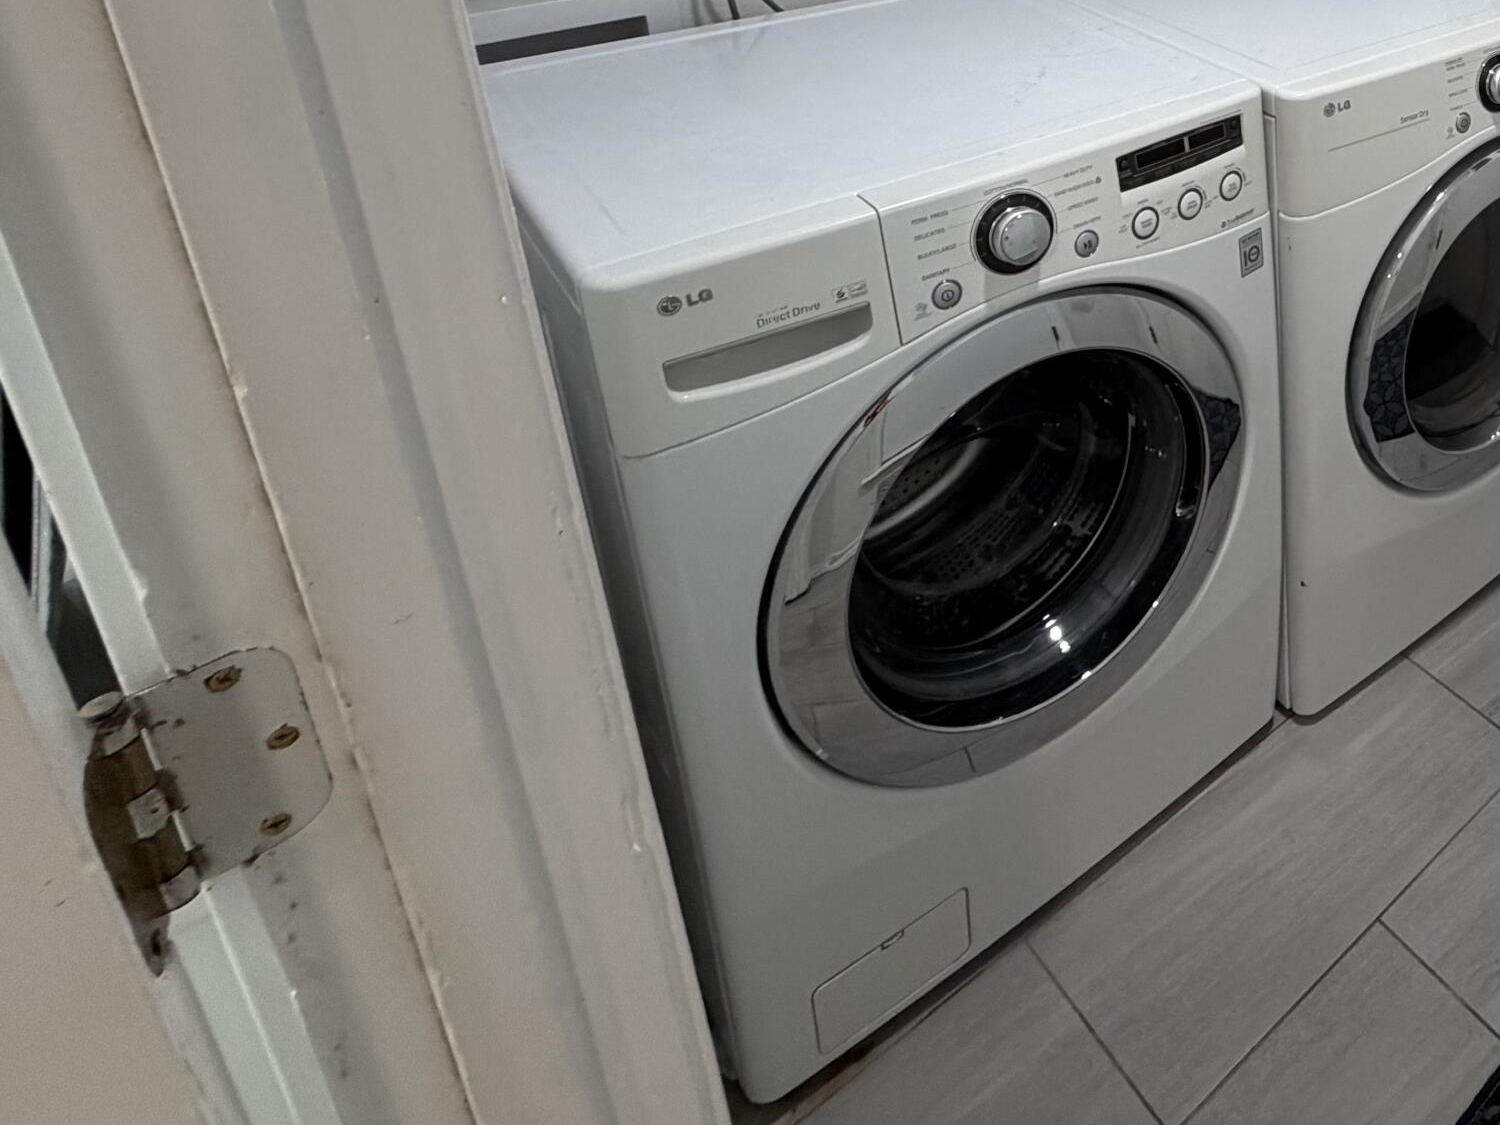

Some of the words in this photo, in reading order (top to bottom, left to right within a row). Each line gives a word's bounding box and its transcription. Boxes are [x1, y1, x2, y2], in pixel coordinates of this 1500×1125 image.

[1337, 99, 1351, 112] LG
[685, 288, 714, 307] LG
[756, 310, 791, 329] Direct
[791, 302, 821, 318] Drive
